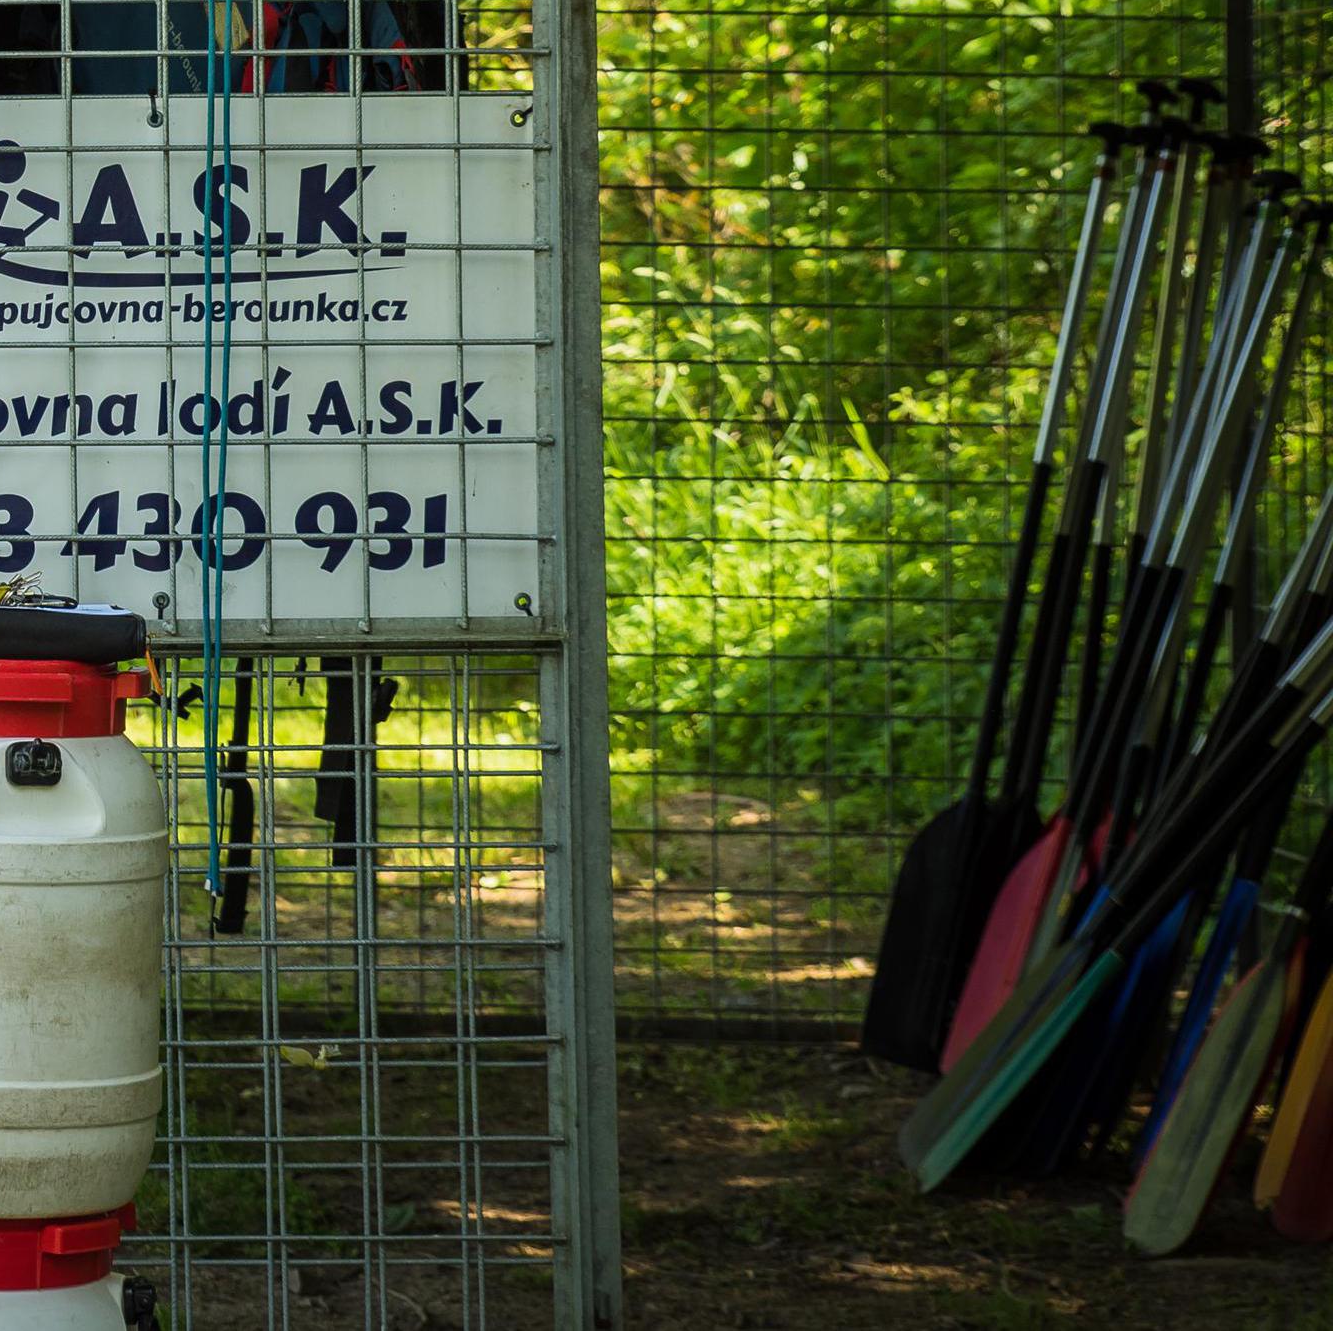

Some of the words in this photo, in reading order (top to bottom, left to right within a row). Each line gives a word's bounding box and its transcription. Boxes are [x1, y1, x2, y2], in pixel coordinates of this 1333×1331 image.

[73, 164, 408, 260] A.S.K.
[157, 365, 293, 436] lodí
[306, 379, 503, 436] A.S.K.
[60, 490, 267, 573] 430
[294, 490, 448, 574] 931
